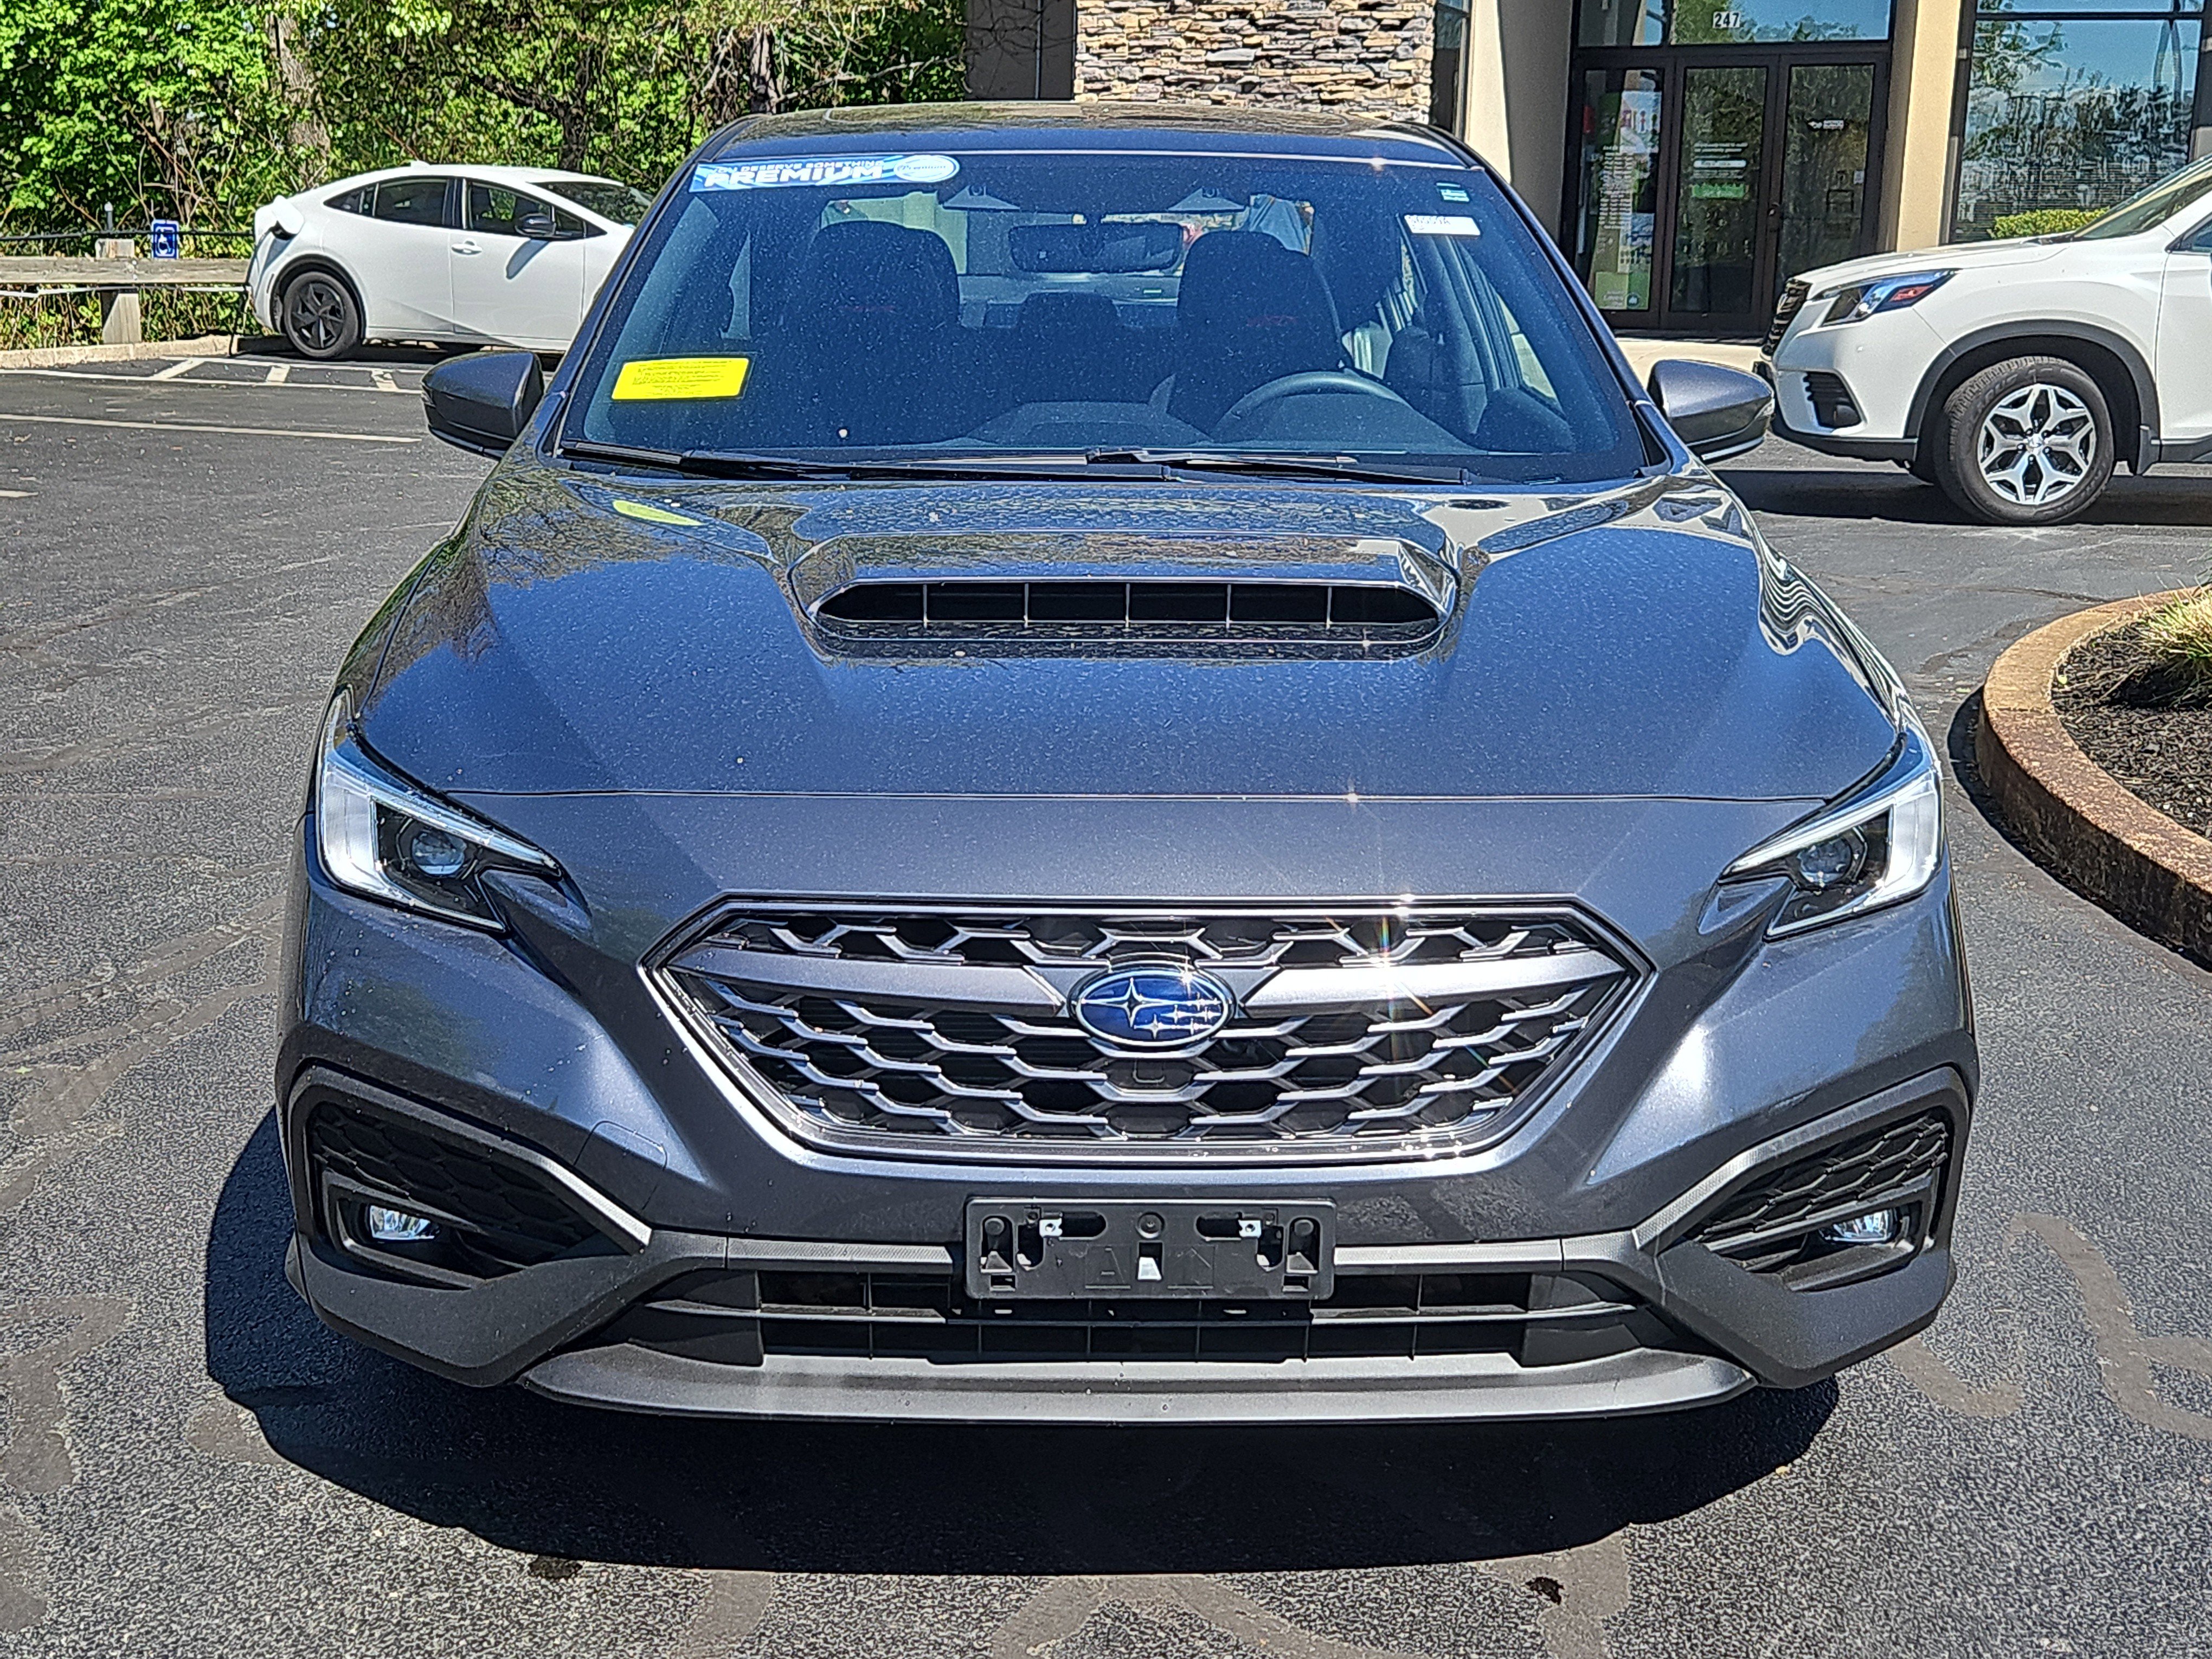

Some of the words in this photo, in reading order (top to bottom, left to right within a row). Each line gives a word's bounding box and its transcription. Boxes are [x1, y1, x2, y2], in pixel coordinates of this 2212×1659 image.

[1714, 12, 1740, 28] 247
[741, 163, 803, 172] DESERVE
[806, 160, 885, 169] SOMETHING
[704, 165, 883, 188] PREMIUM
